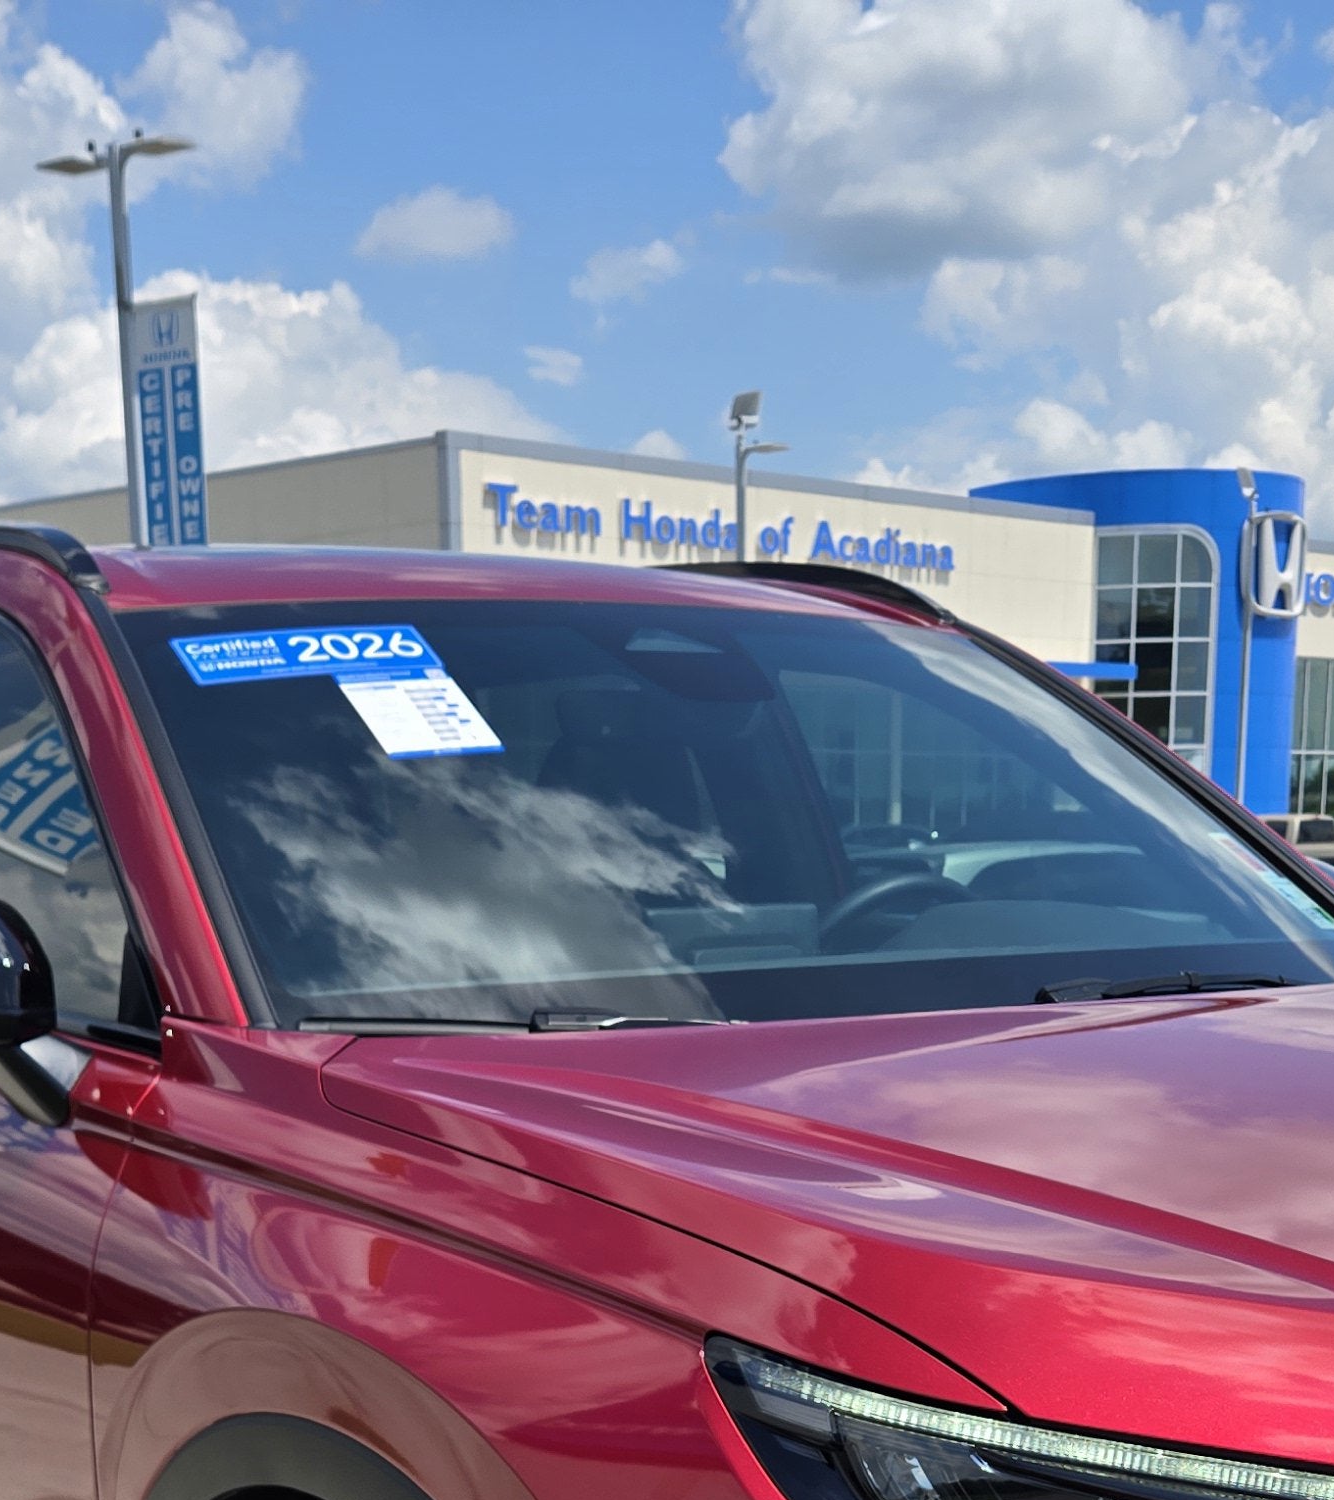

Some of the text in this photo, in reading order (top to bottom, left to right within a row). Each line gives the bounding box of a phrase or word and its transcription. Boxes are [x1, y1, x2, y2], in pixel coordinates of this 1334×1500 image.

[175, 369, 195, 432] PRE
[485, 482, 956, 571] Team Honda of Acadiana
[185, 631, 424, 662] Certified 2026
